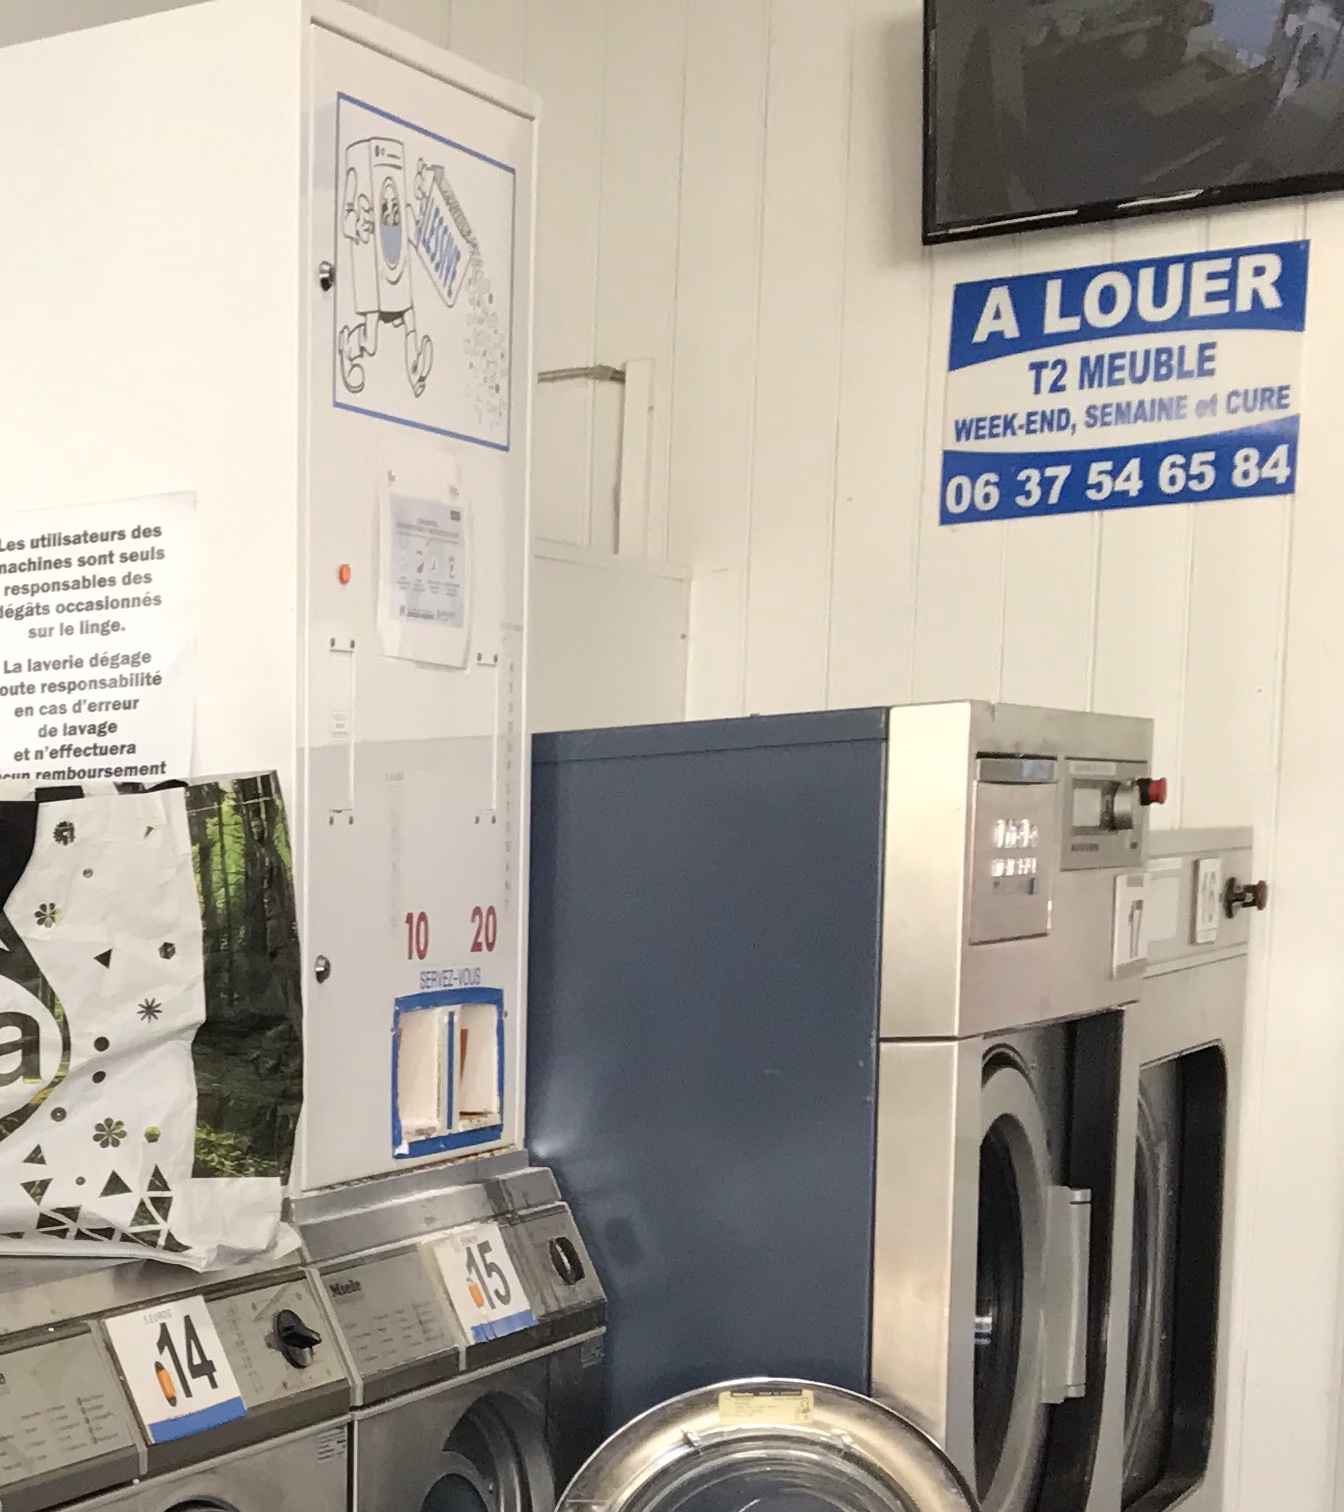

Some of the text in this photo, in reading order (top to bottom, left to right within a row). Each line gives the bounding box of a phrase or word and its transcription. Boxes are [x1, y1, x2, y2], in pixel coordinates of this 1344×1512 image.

[972, 254, 1282, 343] A LOUER
[1029, 342, 1216, 395] T2 MEUBLE
[954, 408, 1076, 442] WEEK-END,
[1084, 396, 1187, 428] SEMAINE
[1226, 385, 1290, 414] CURE
[946, 444, 1291, 513] 06 37 54 65 84
[30, 530, 126, 549] utilisateurs
[132, 525, 162, 539] des
[78, 550, 114, 567] sont
[120, 546, 165, 563] seuls
[4, 572, 152, 597] responsables des
[56, 592, 162, 614] occasionnés
[28, 620, 125, 638] sur le linge.
[4, 652, 151, 674] La laverie dégage
[405, 906, 497, 960] 10 20
[329, 1280, 361, 1297] Miele
[466, 1240, 511, 1309] 15
[155, 1315, 218, 1405] 14
